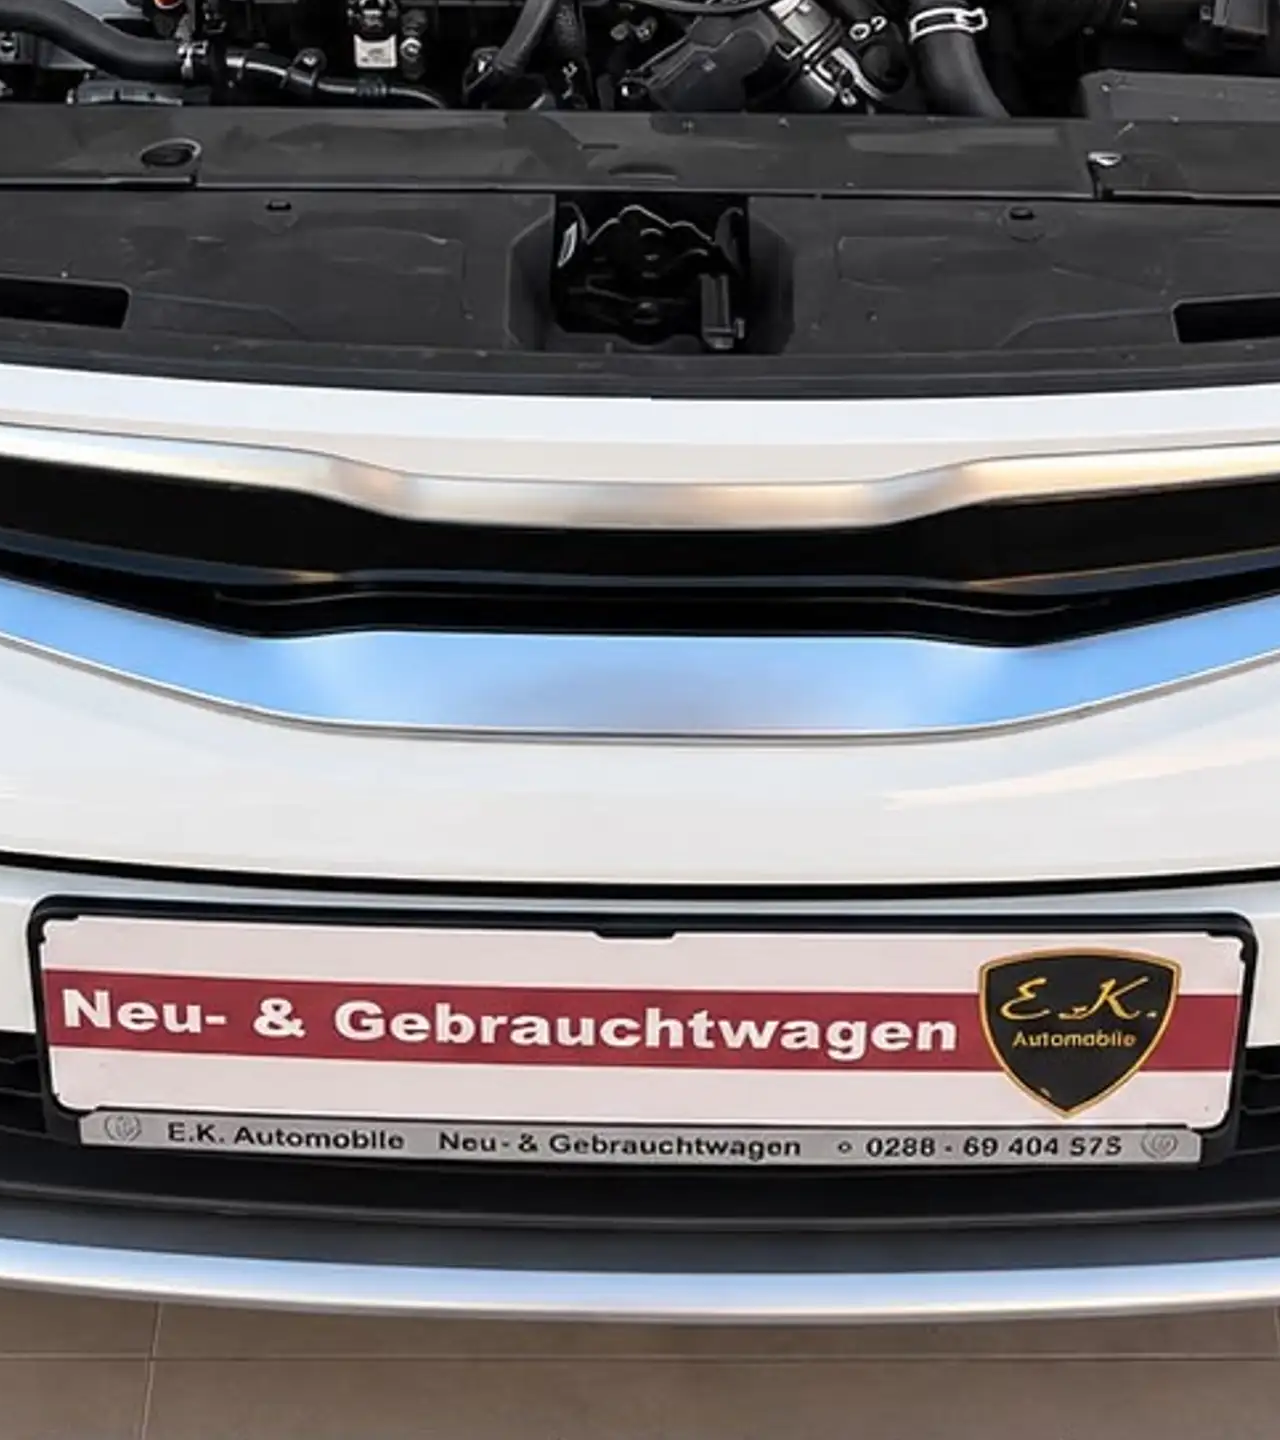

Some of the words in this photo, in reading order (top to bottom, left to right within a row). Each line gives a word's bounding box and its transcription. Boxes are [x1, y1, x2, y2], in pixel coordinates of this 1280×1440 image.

[61, 988, 227, 1034] Neu-
[252, 997, 307, 1038] &
[333, 1000, 958, 1062] Gebrauchtwagen
[1011, 1029, 1138, 1048] Automobile
[167, 1121, 225, 1144] E.K.
[233, 1125, 406, 1150] Automobile
[518, 1133, 538, 1153] &
[549, 1134, 802, 1162] Gebrauchtwagen
[865, 1136, 936, 1158] 0288
[1008, 1136, 1059, 1157] 404
